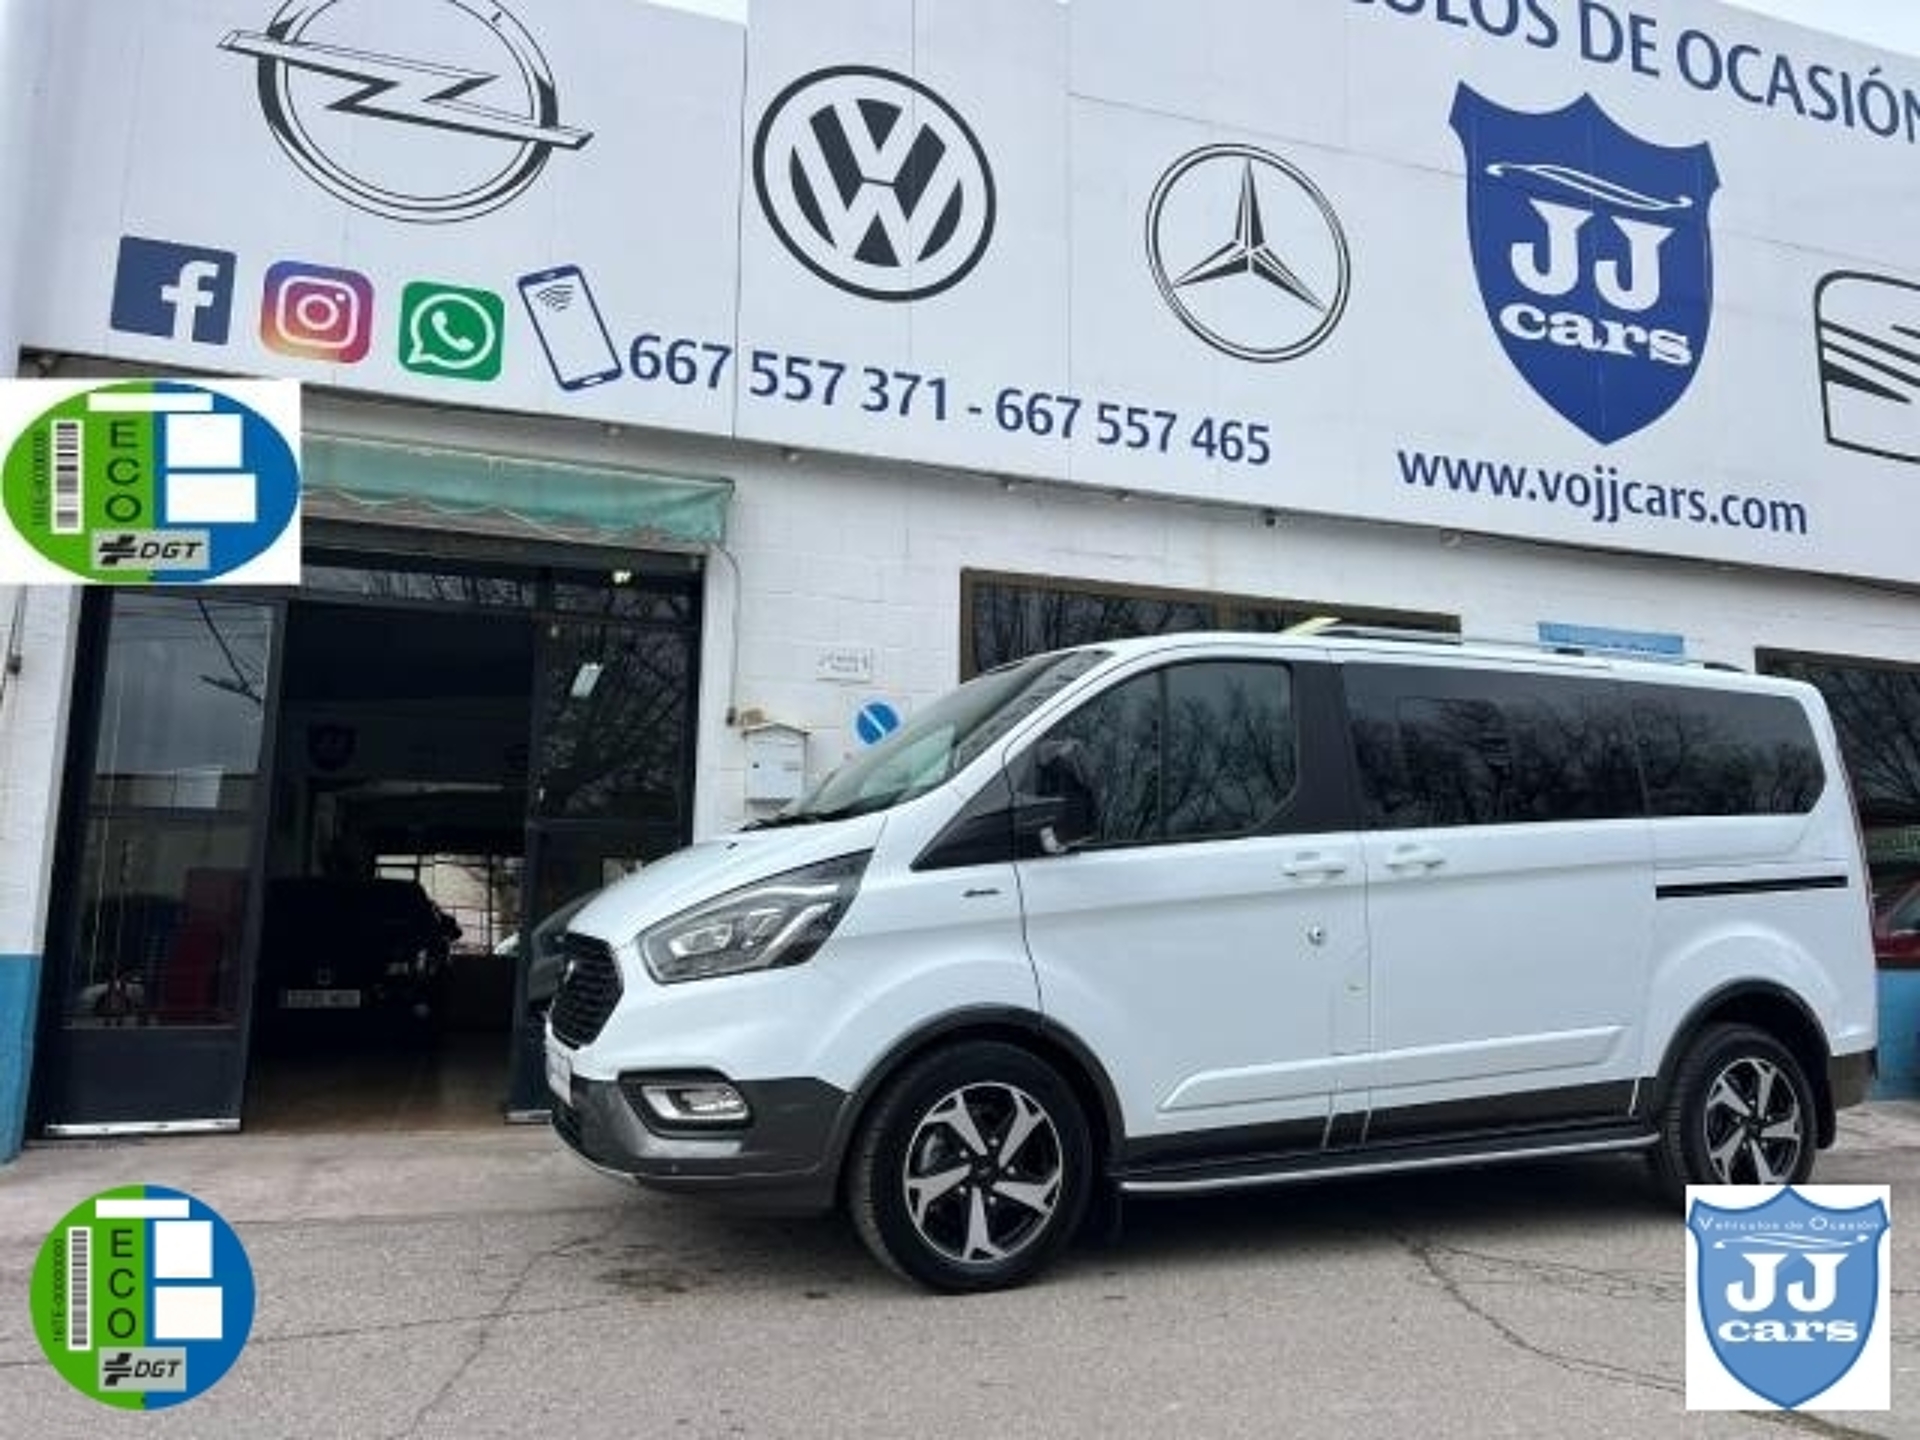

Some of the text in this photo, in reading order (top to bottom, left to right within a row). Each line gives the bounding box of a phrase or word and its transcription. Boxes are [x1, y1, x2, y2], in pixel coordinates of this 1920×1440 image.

[1578, 0, 1660, 78] DE
[1511, 198, 1675, 312] JJ
[1500, 303, 1693, 366] cars
[628, 333, 733, 389] 667
[749, 350, 847, 406] 557
[861, 367, 947, 422] 371
[995, 388, 1082, 439] 667
[1096, 402, 1178, 453] 557
[1190, 417, 1271, 466] 465
[1396, 450, 1808, 536] www.vojjcars.com
